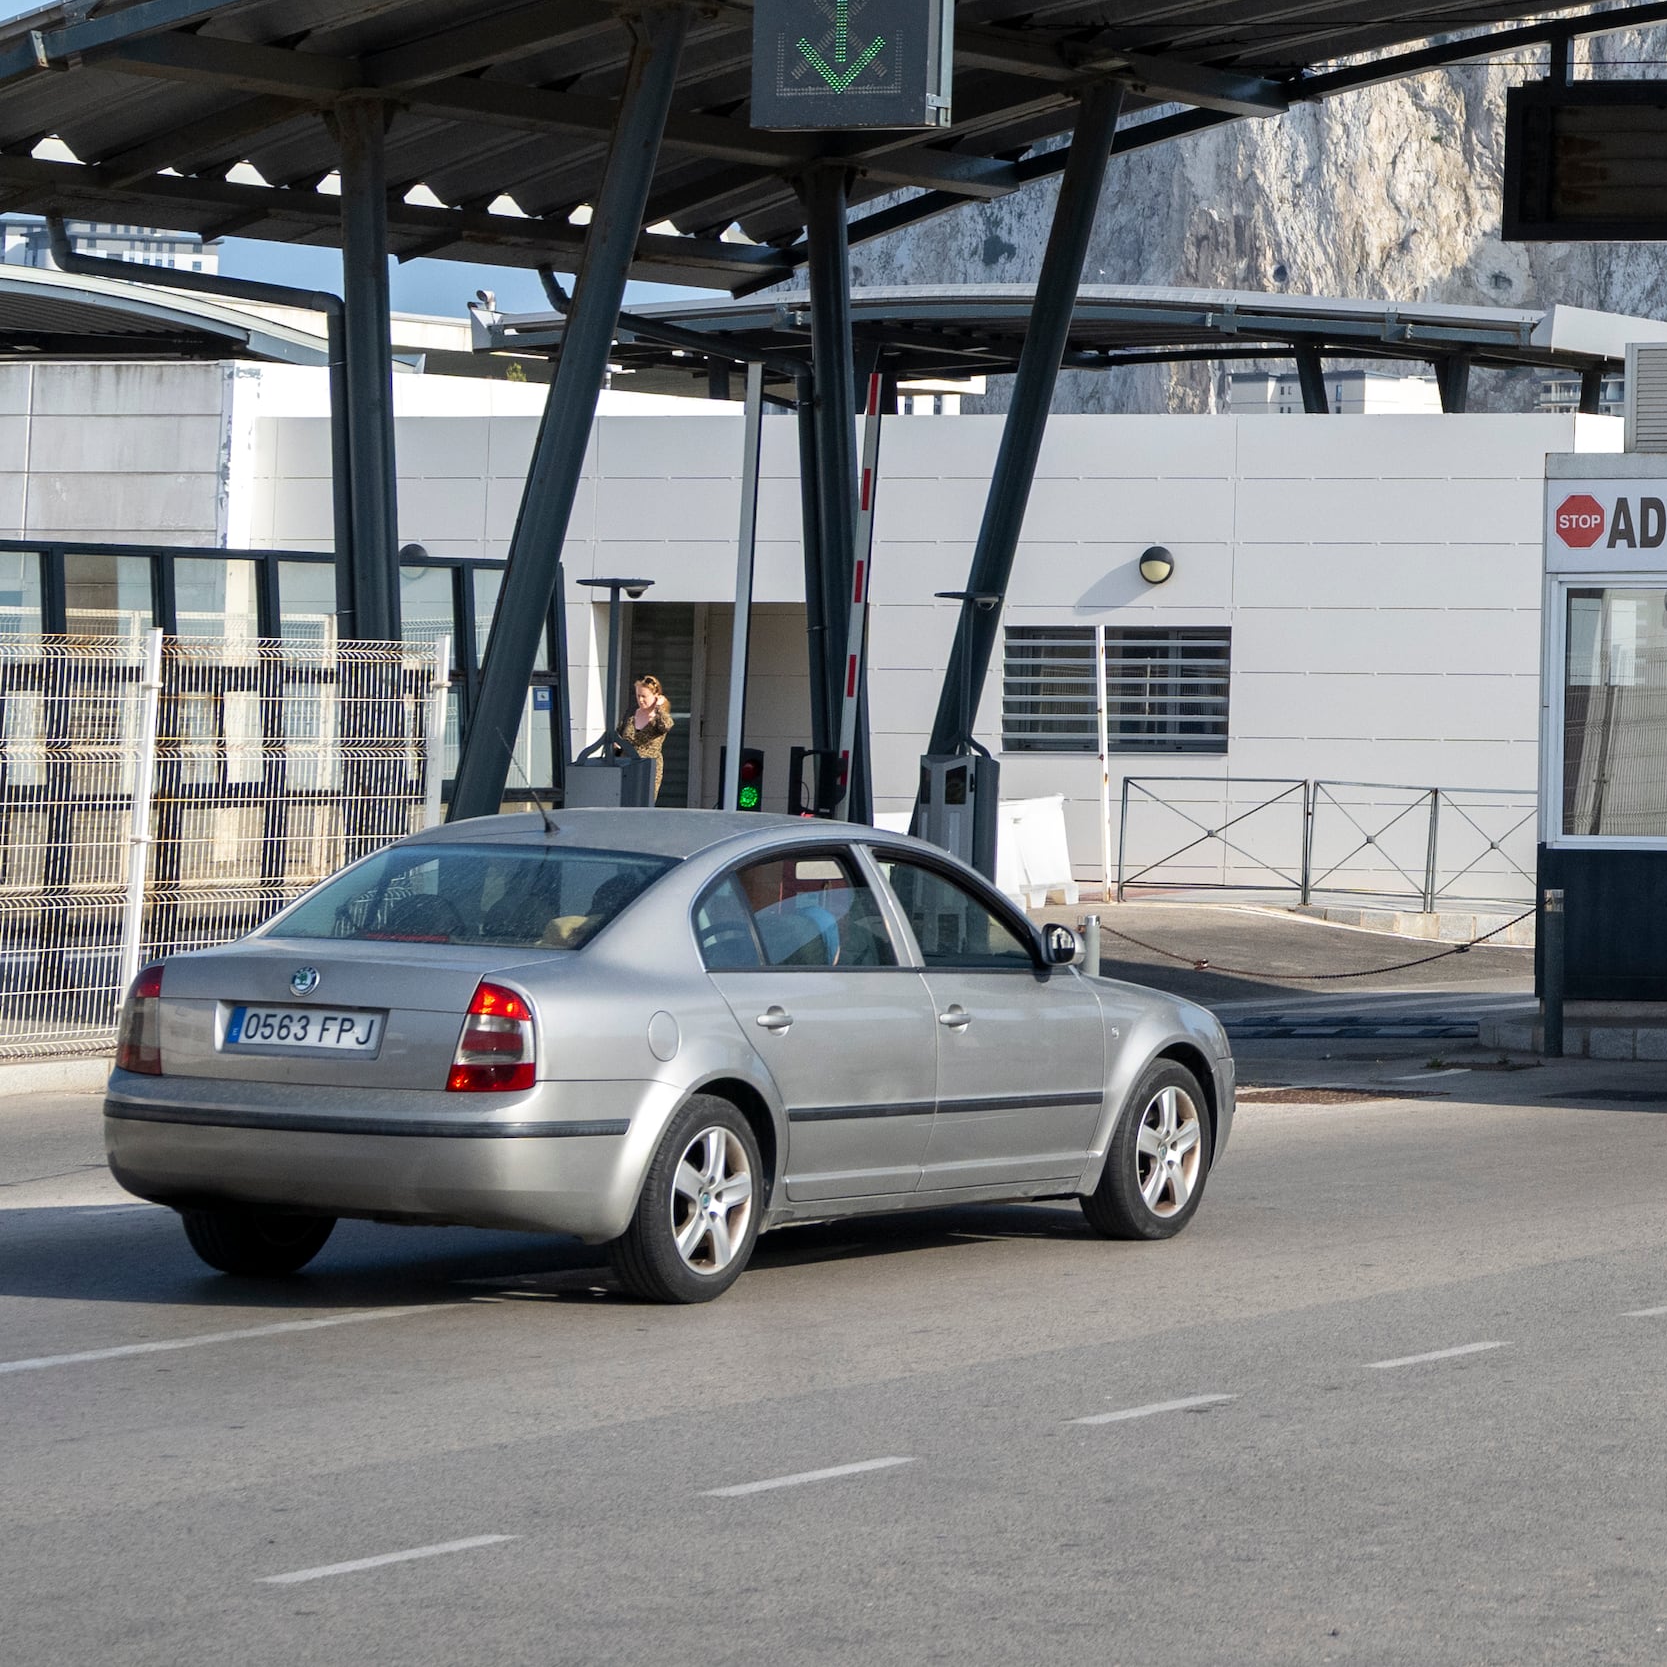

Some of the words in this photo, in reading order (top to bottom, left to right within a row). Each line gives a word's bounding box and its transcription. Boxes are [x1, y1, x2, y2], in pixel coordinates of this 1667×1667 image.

[1559, 514, 1601, 529] STOP
[244, 1013, 310, 1042] 0563
[318, 1016, 375, 1046] FPJ
